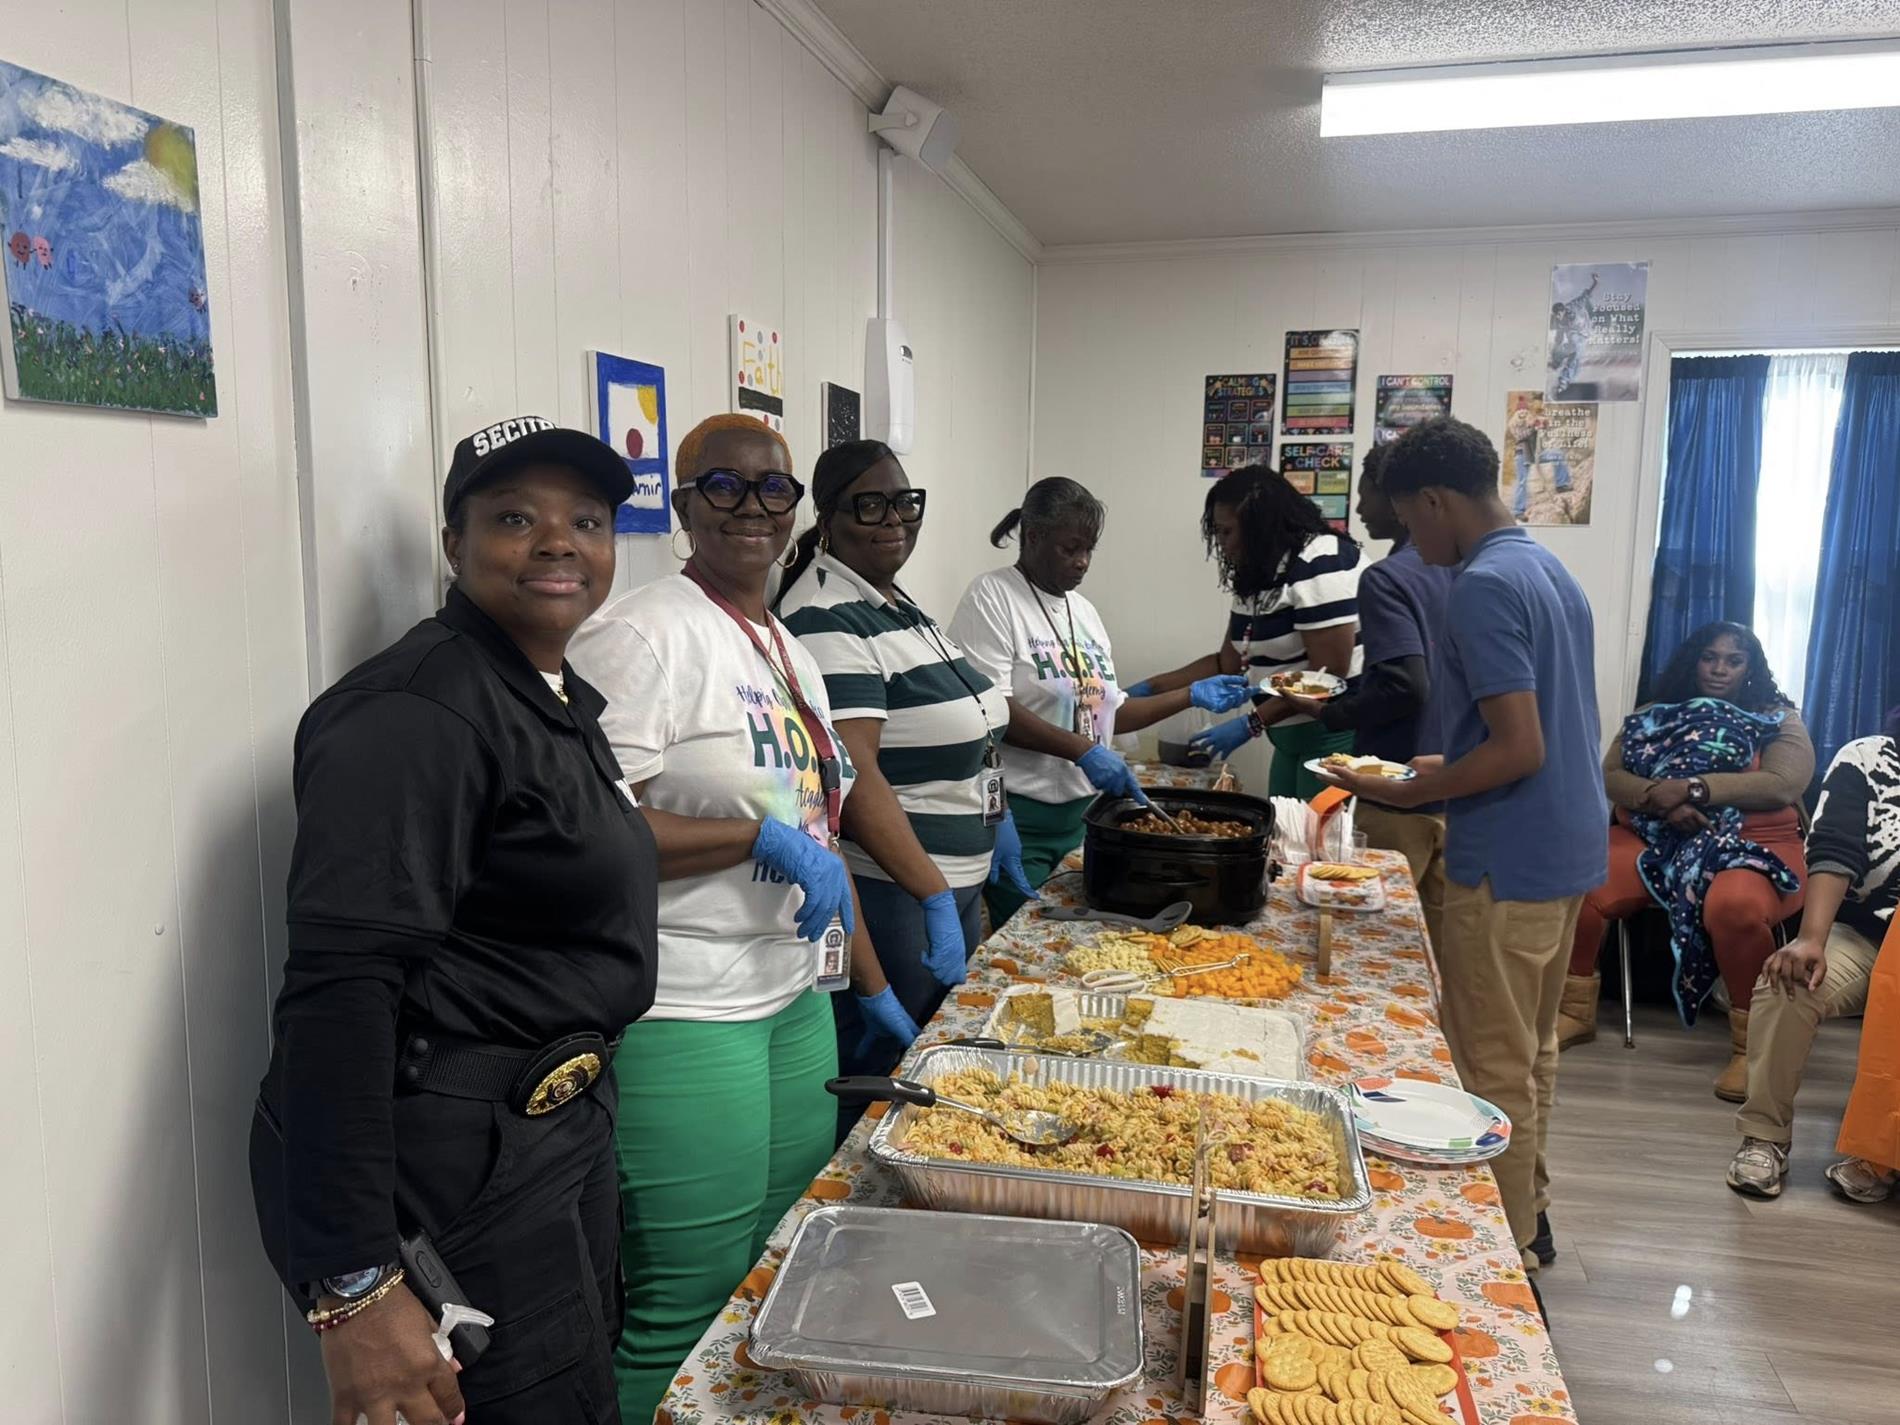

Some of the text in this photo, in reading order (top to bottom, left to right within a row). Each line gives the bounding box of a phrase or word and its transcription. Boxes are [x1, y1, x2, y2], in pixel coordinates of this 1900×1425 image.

[1610, 313, 1641, 323] What
[1594, 324, 1637, 335] Really
[1220, 377, 1260, 388] CALMG
[1386, 376, 1410, 386] CAN'T
[1410, 376, 1450, 387] CONTROL
[1216, 387, 1265, 397] STRATEGS
[1284, 445, 1352, 457] SELF-CARE
[1295, 457, 1341, 469] CHECK
